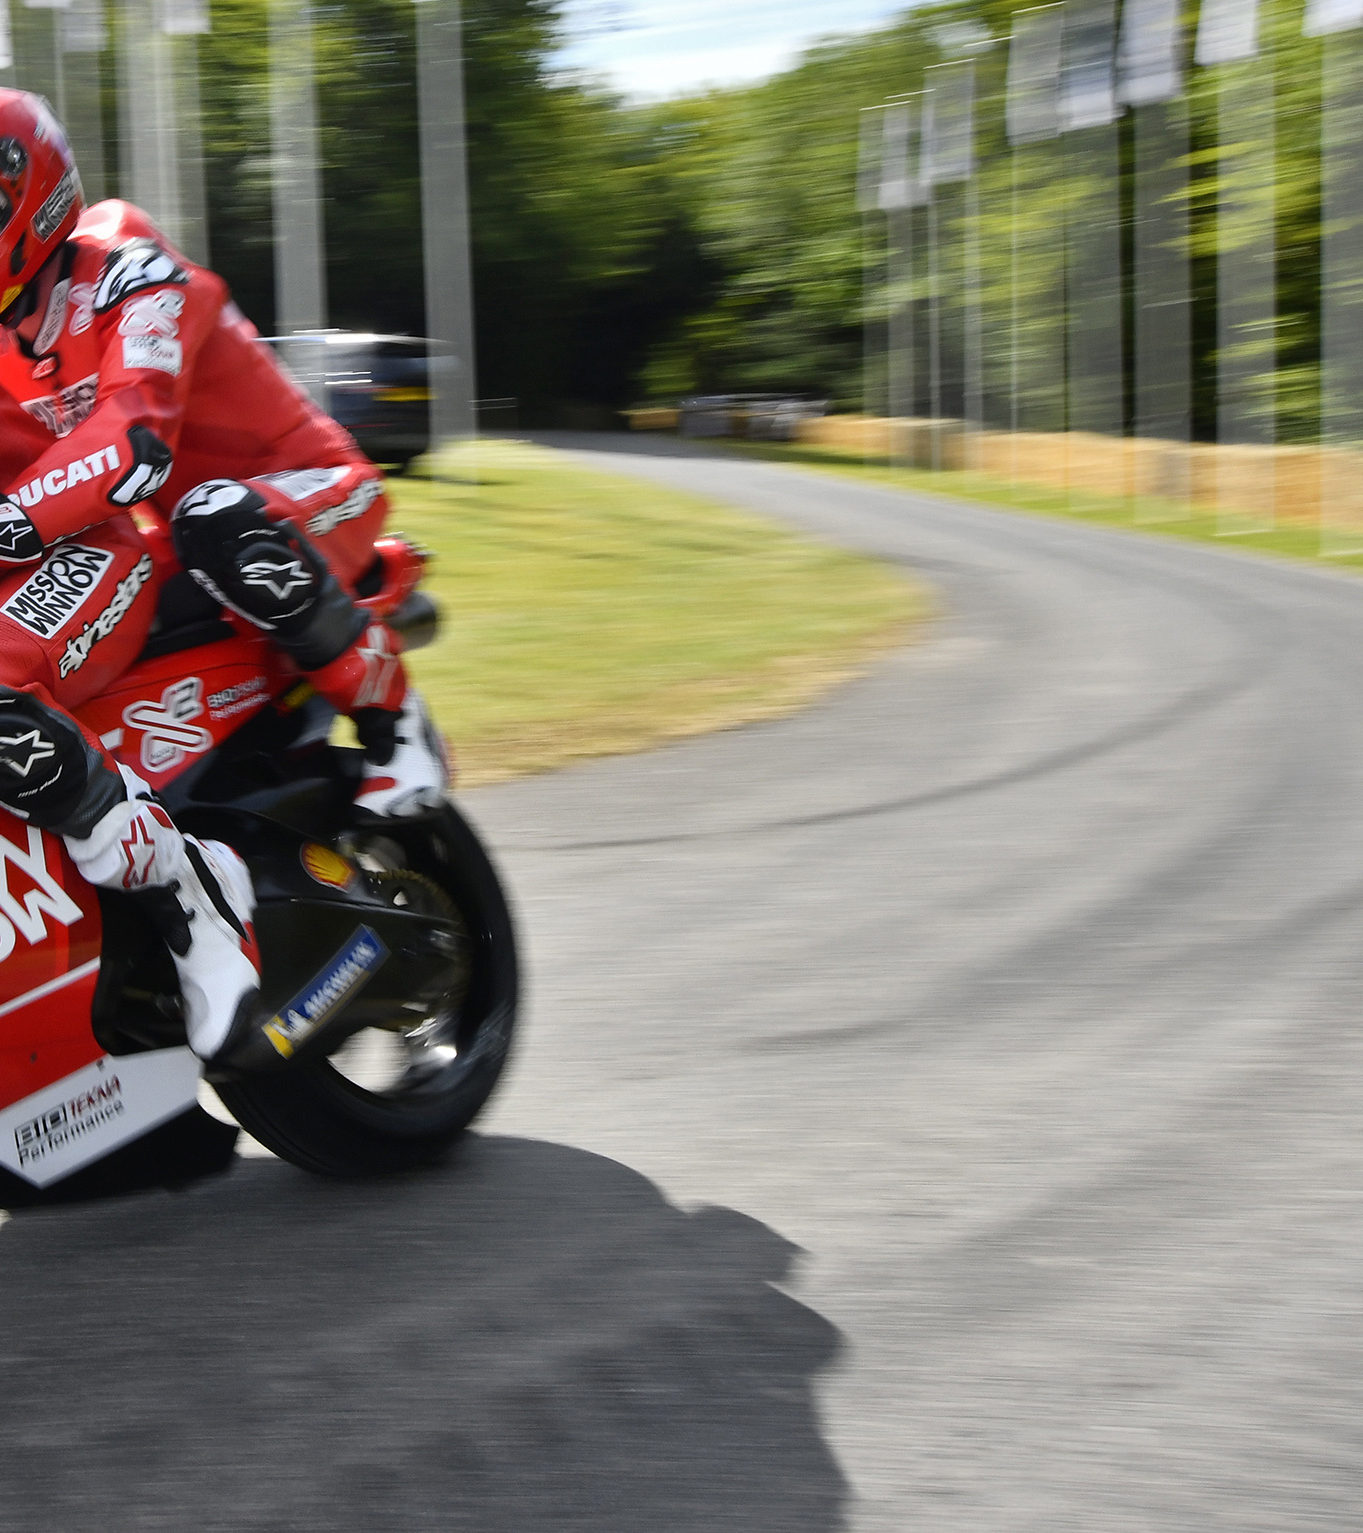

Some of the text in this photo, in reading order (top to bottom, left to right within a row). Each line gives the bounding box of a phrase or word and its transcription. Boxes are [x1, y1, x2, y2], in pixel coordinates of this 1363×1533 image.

[5, 544, 84, 622] MISSION
[20, 552, 110, 636] WINNOW
[17, 1099, 126, 1169] Performance
